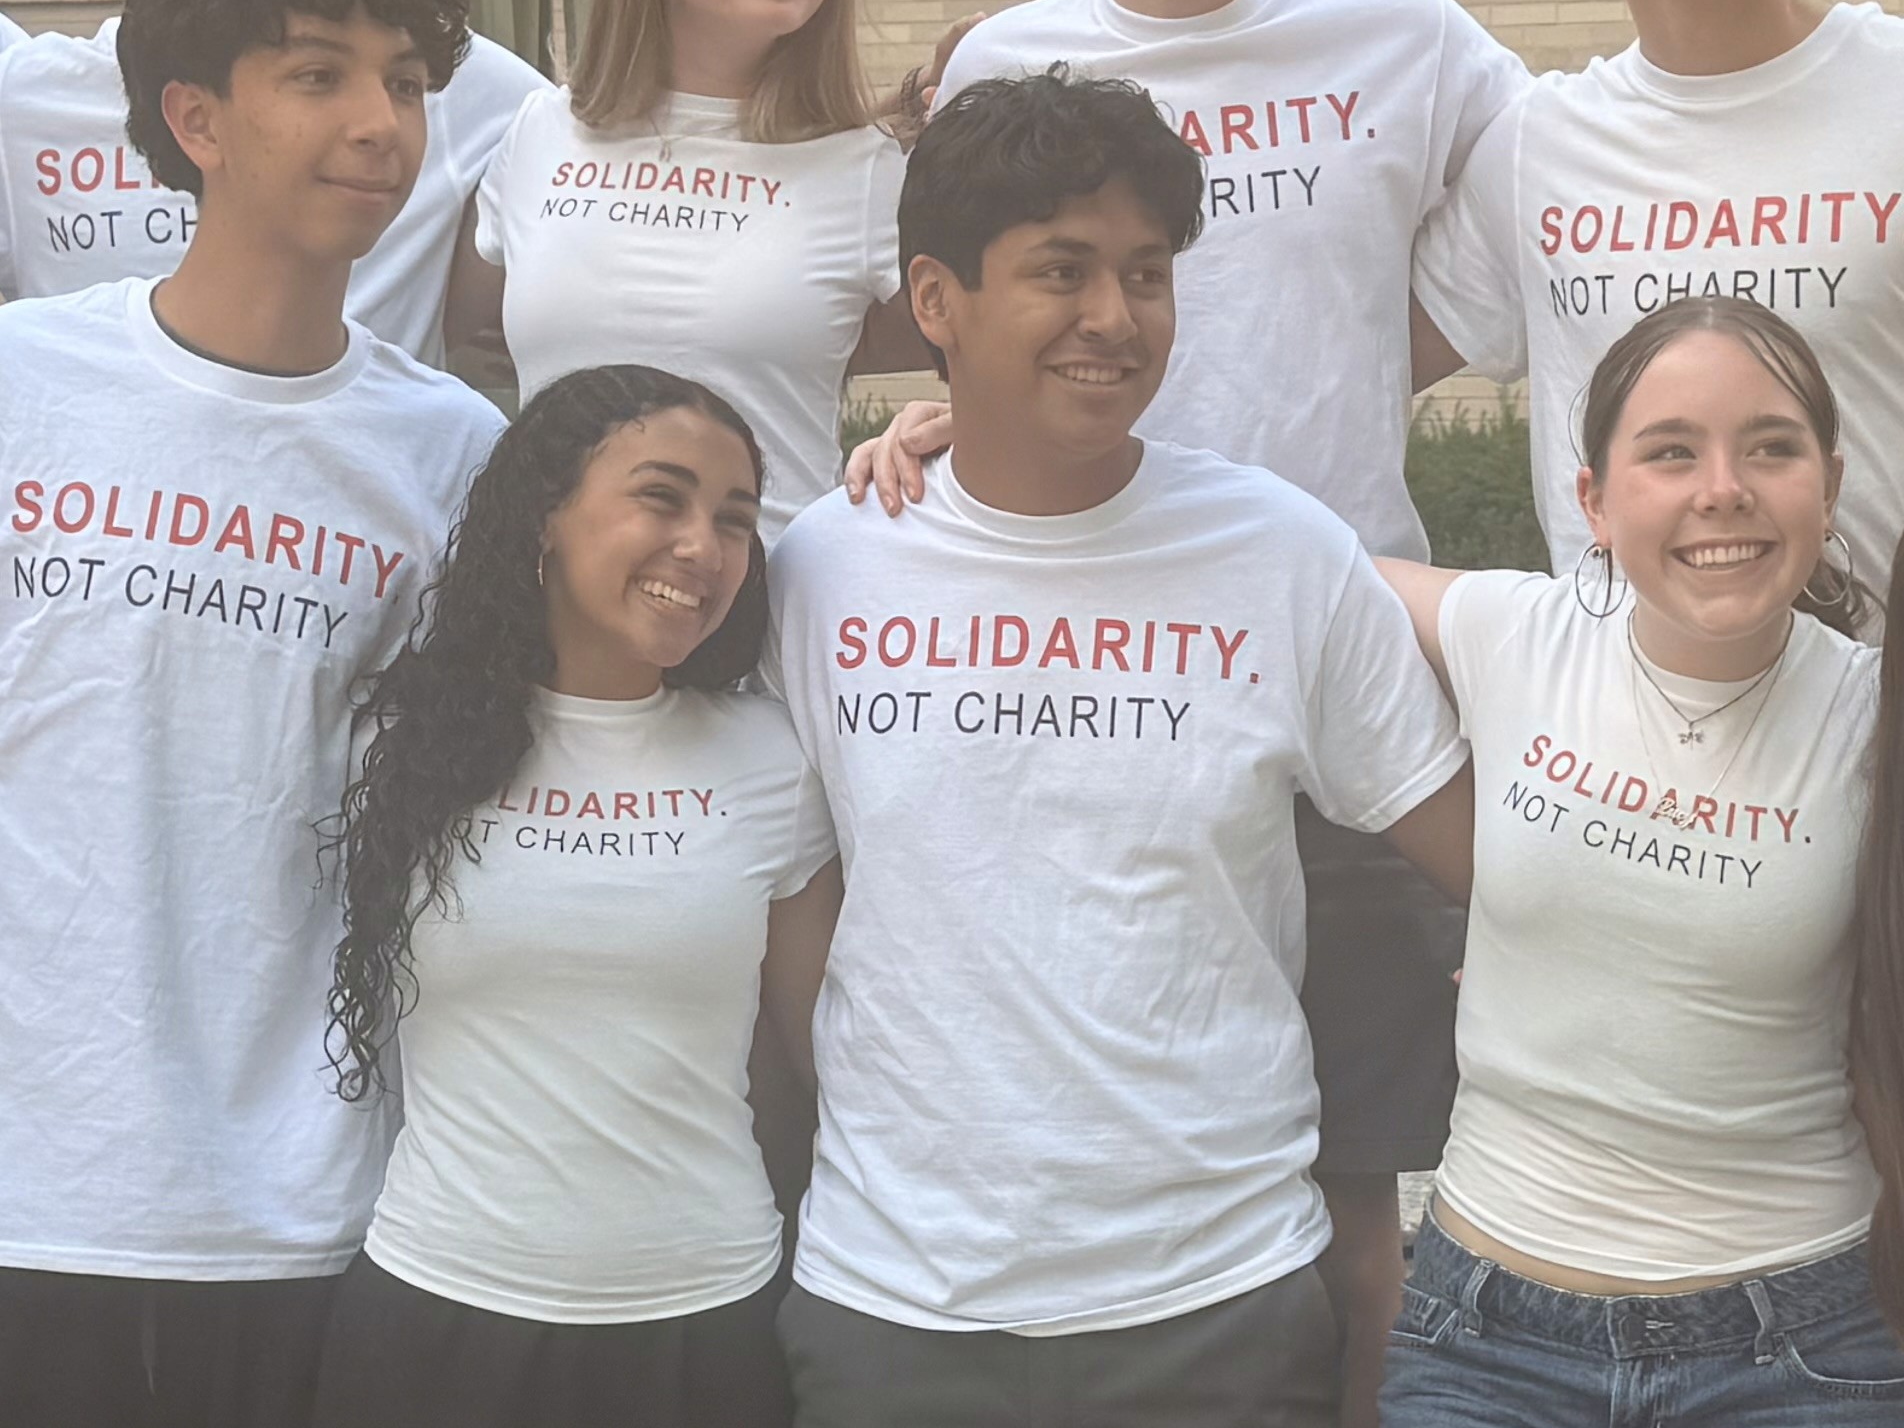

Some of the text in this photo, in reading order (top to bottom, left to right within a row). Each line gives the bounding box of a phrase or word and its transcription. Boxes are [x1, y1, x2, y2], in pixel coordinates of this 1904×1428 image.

[1179, 90, 1376, 157] ARITY.
[551, 161, 791, 208] SOLIDARITY.
[1210, 166, 1321, 218] RITY
[46, 210, 124, 253] NOT
[540, 197, 750, 233] NOT CHARITY
[1549, 266, 1848, 317] NOT CHARITY
[14, 556, 349, 649] NOT CHARITY
[836, 615, 1261, 684] SOLIDARITY.
[837, 690, 1191, 741] NOT CHARITY
[498, 782, 728, 819] LIDARITY.
[1523, 734, 1812, 845] SOLIDARITY.
[515, 826, 686, 856] CHARITY
[1502, 781, 1763, 889] NOT CHARITY
